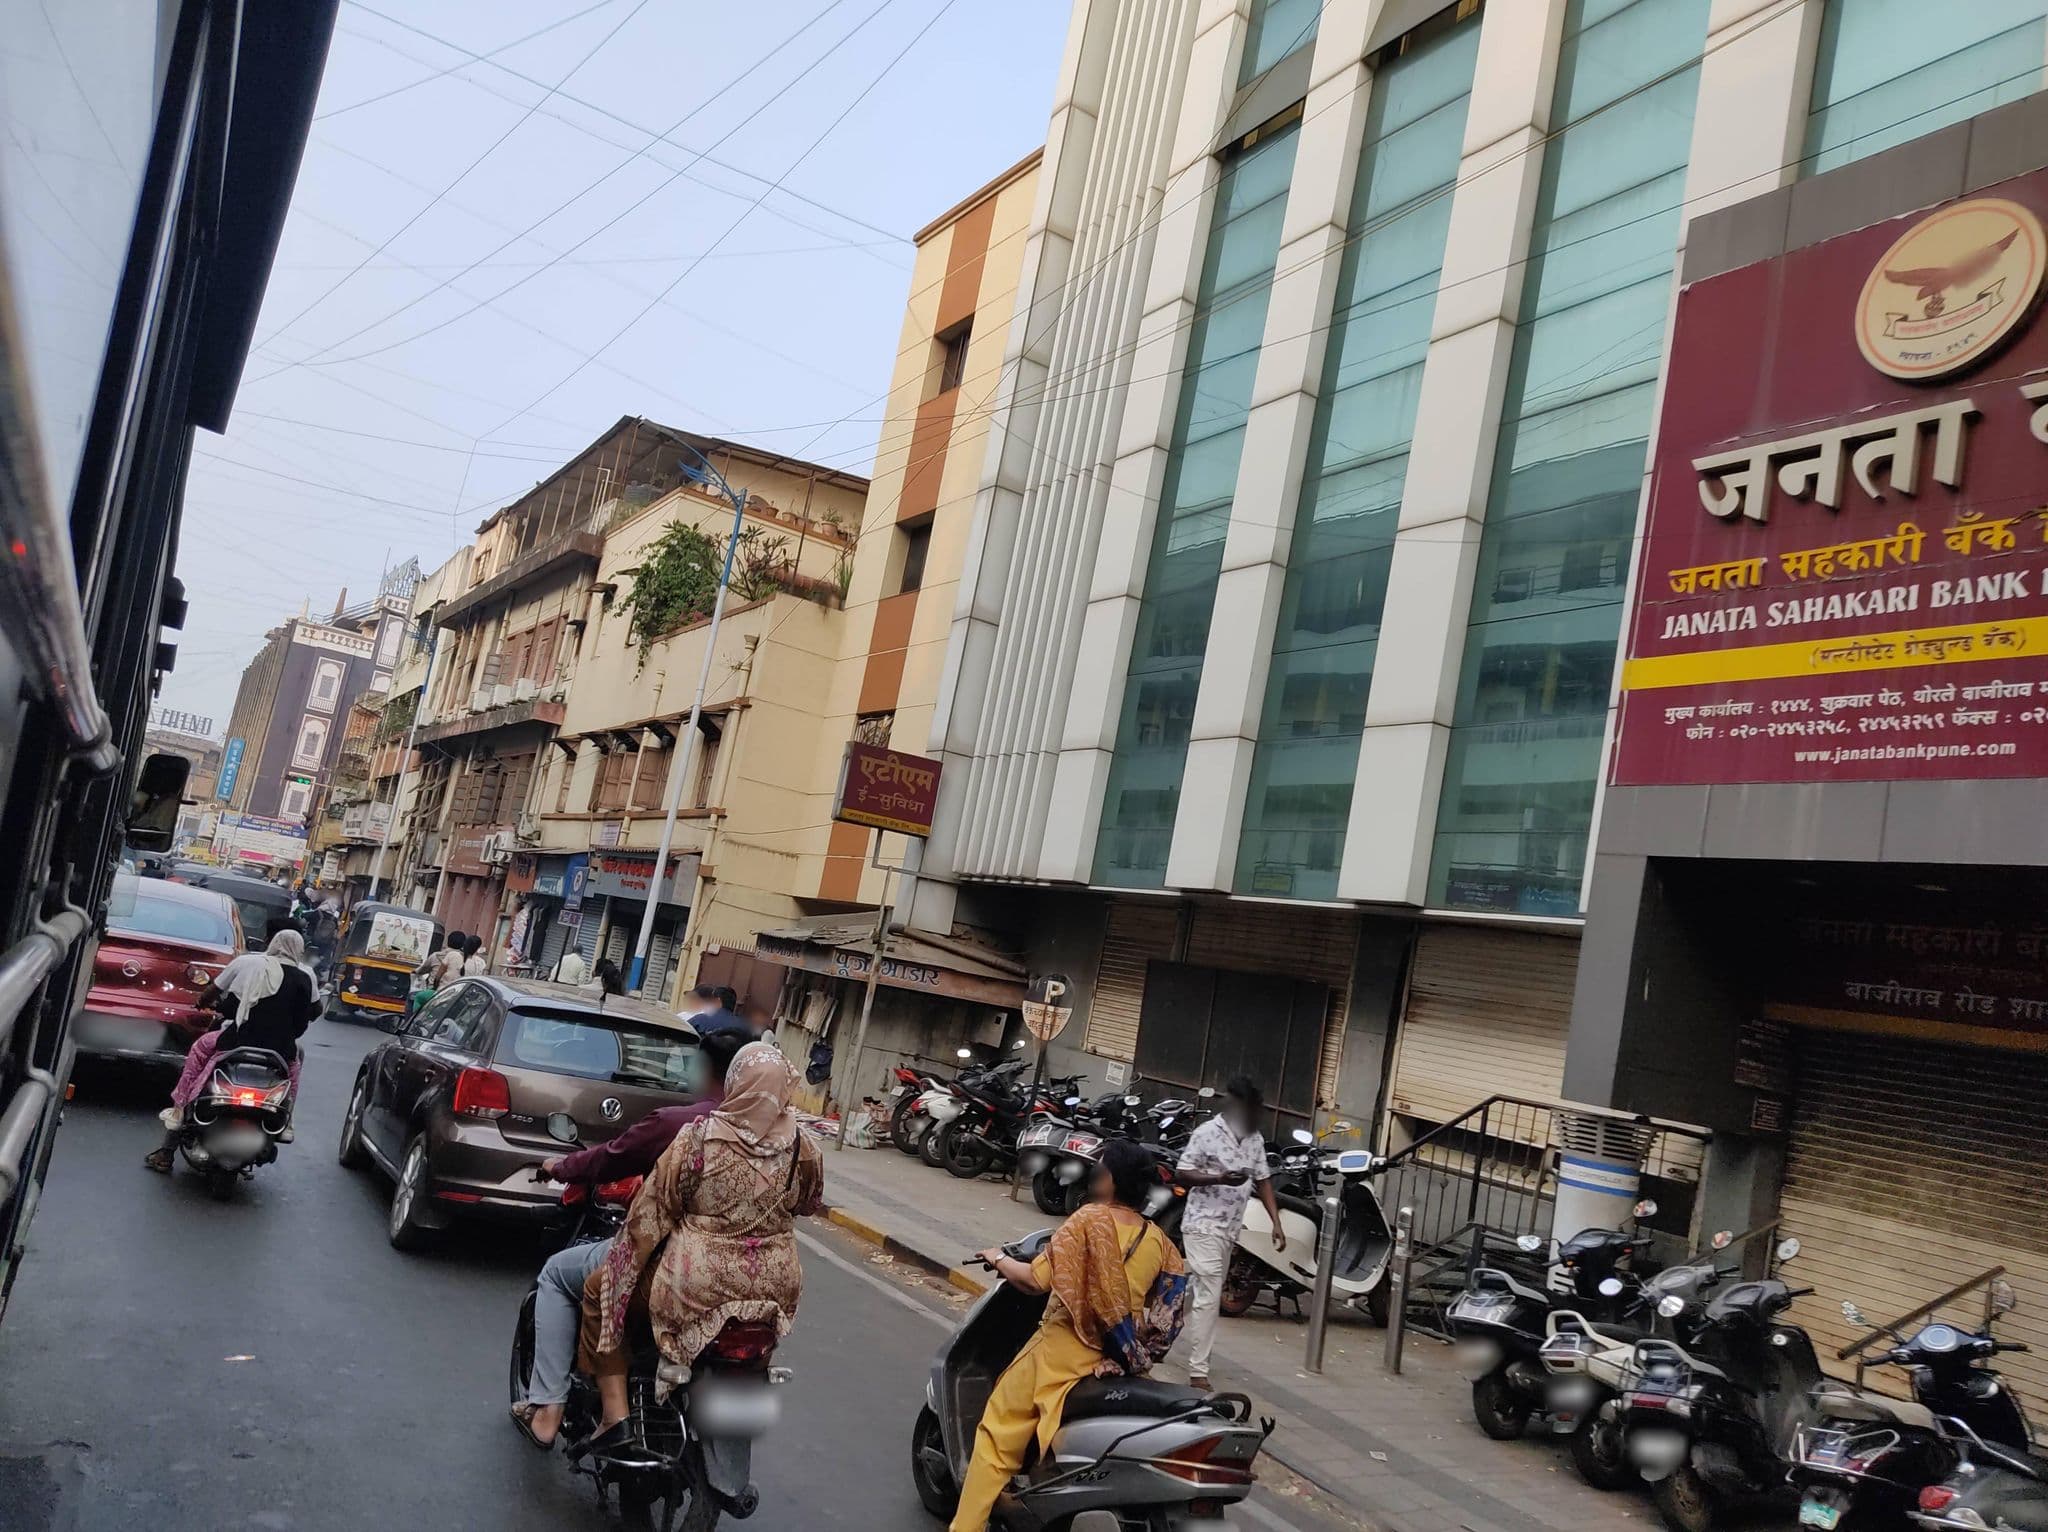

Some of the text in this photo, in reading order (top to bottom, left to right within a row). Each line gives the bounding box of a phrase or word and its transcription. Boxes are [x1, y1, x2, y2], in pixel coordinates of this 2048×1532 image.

[1691, 398, 1981, 522] जनता
[1668, 557, 1767, 594] जनता
[1780, 522, 1927, 580] सहकारी
[1660, 606, 1757, 640] JANATA
[1765, 583, 1918, 628] SAHAKARI
[1930, 569, 2030, 608] BANK
[1664, 706, 1695, 725] मुख्य
[1699, 699, 1754, 717] कार्यालय
[1771, 698, 1814, 715] १४४४,
[1820, 693, 1874, 715] शुक्रवार
[1878, 688, 1906, 707] पेठ,
[1913, 683, 1957, 704] थोरले
[1962, 679, 2034, 702] बाजीराव
[1685, 723, 1714, 740] फोन
[1795, 742, 2017, 764] www.janatabankpune.com
[860, 754, 935, 795] एटीएम
[857, 785, 925, 814] ई-सुविधा
[1044, 980, 1066, 1003] P
[1843, 980, 1943, 1009] बाजीराव
[1954, 986, 2000, 1015] रोड
[511, 1114, 534, 1124] POLO
